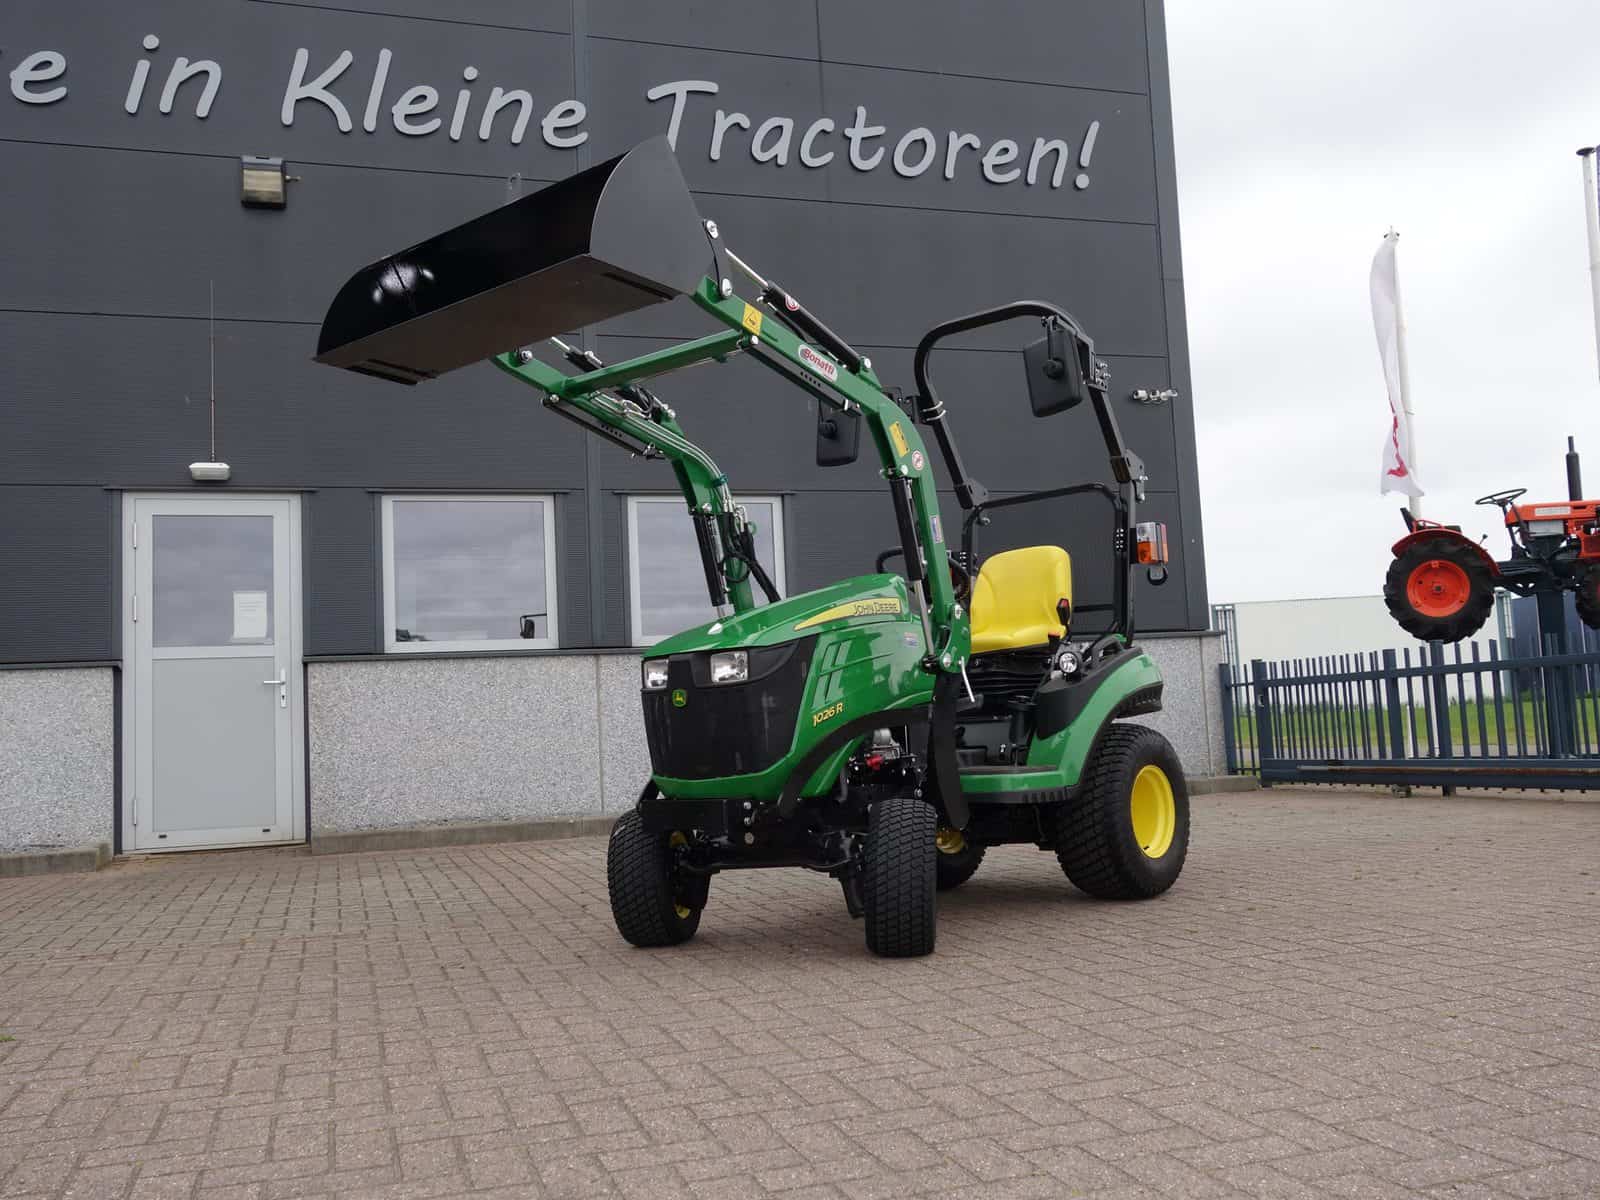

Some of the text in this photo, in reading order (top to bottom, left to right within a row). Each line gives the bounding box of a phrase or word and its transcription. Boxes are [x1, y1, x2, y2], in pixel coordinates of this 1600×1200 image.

[124, 34, 223, 118] in
[281, 47, 589, 149] Kleine
[647, 79, 1100, 189] Tractoren!
[803, 348, 835, 375] Bonatti
[812, 702, 844, 728] 1026 R
